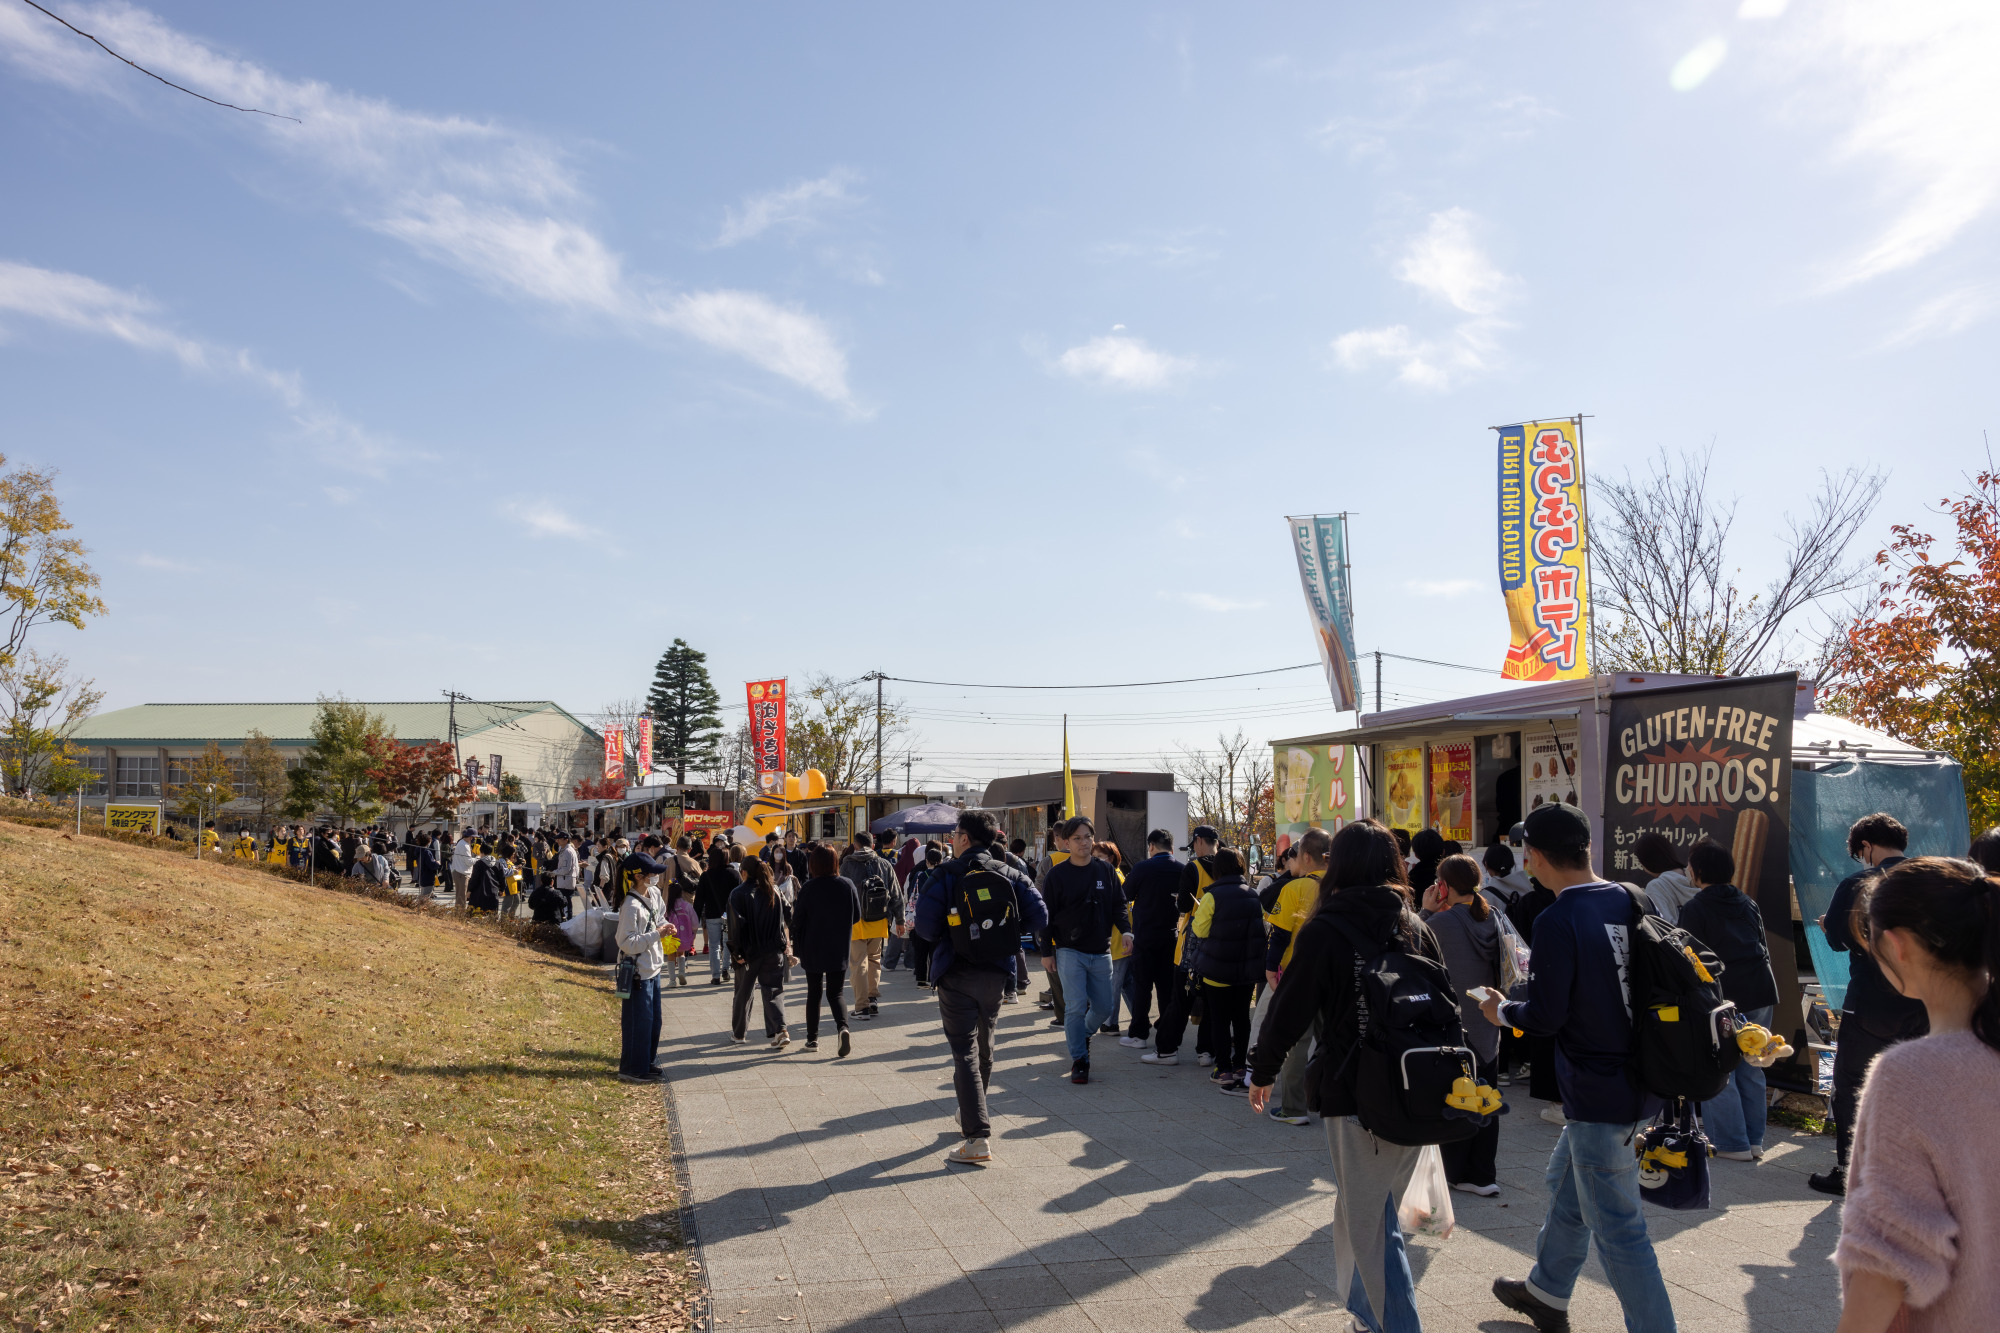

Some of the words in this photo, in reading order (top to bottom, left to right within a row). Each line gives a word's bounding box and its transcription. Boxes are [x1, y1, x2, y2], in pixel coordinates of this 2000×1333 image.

[1620, 705, 1779, 758] GLUTEN-FREE
[1532, 744, 1557, 754] CHURROS
[1560, 743, 1574, 751] ENU
[1615, 757, 1781, 804] CHURROS!
[110, 810, 157, 819] ファンクラブ
[684, 814, 729, 823] ケバブキッチン
[1408, 993, 1431, 1003] BREX
